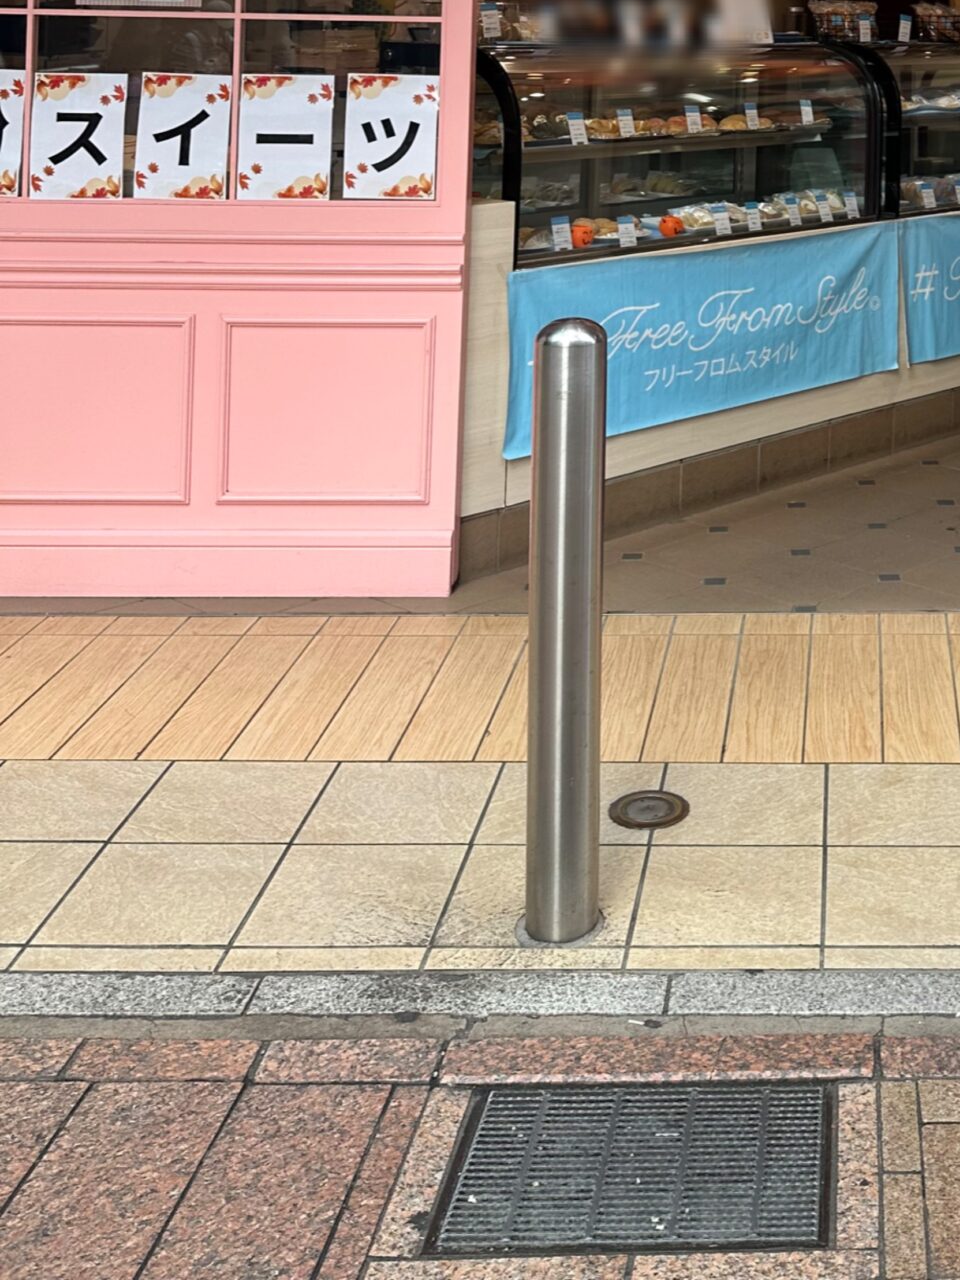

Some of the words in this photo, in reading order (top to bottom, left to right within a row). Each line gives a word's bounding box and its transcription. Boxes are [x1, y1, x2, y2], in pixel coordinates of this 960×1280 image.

[644, 341, 799, 392] フリーフロムスタイル
